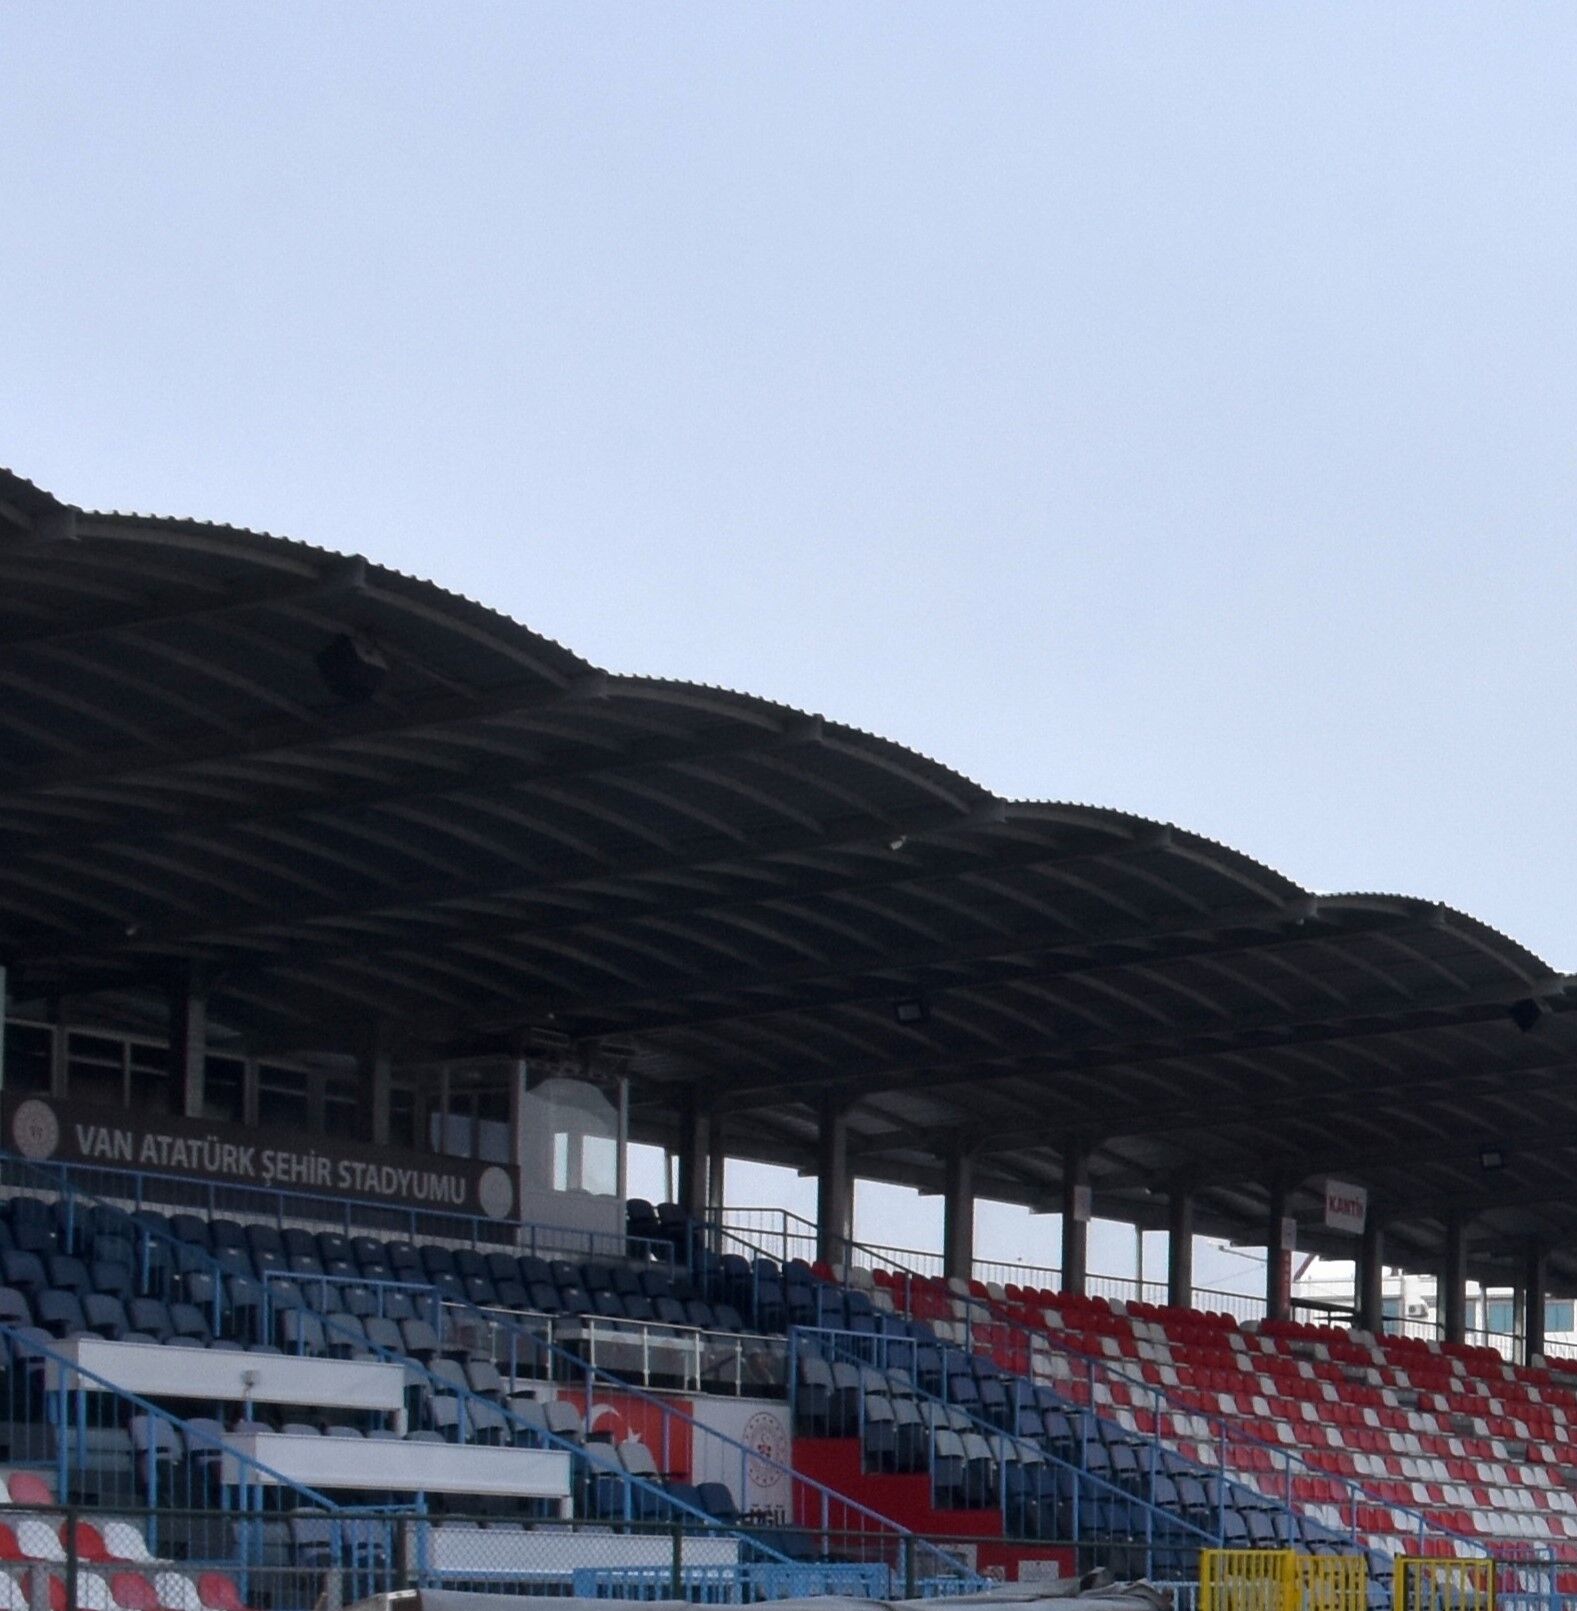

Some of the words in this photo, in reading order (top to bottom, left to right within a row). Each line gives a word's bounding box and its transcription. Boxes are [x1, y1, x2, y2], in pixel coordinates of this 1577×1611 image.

[76, 1123, 133, 1161] VAN
[140, 1133, 255, 1176] ATATÜRK
[261, 1149, 332, 1188] ŞEHİR
[337, 1159, 466, 1204] STADYUMU
